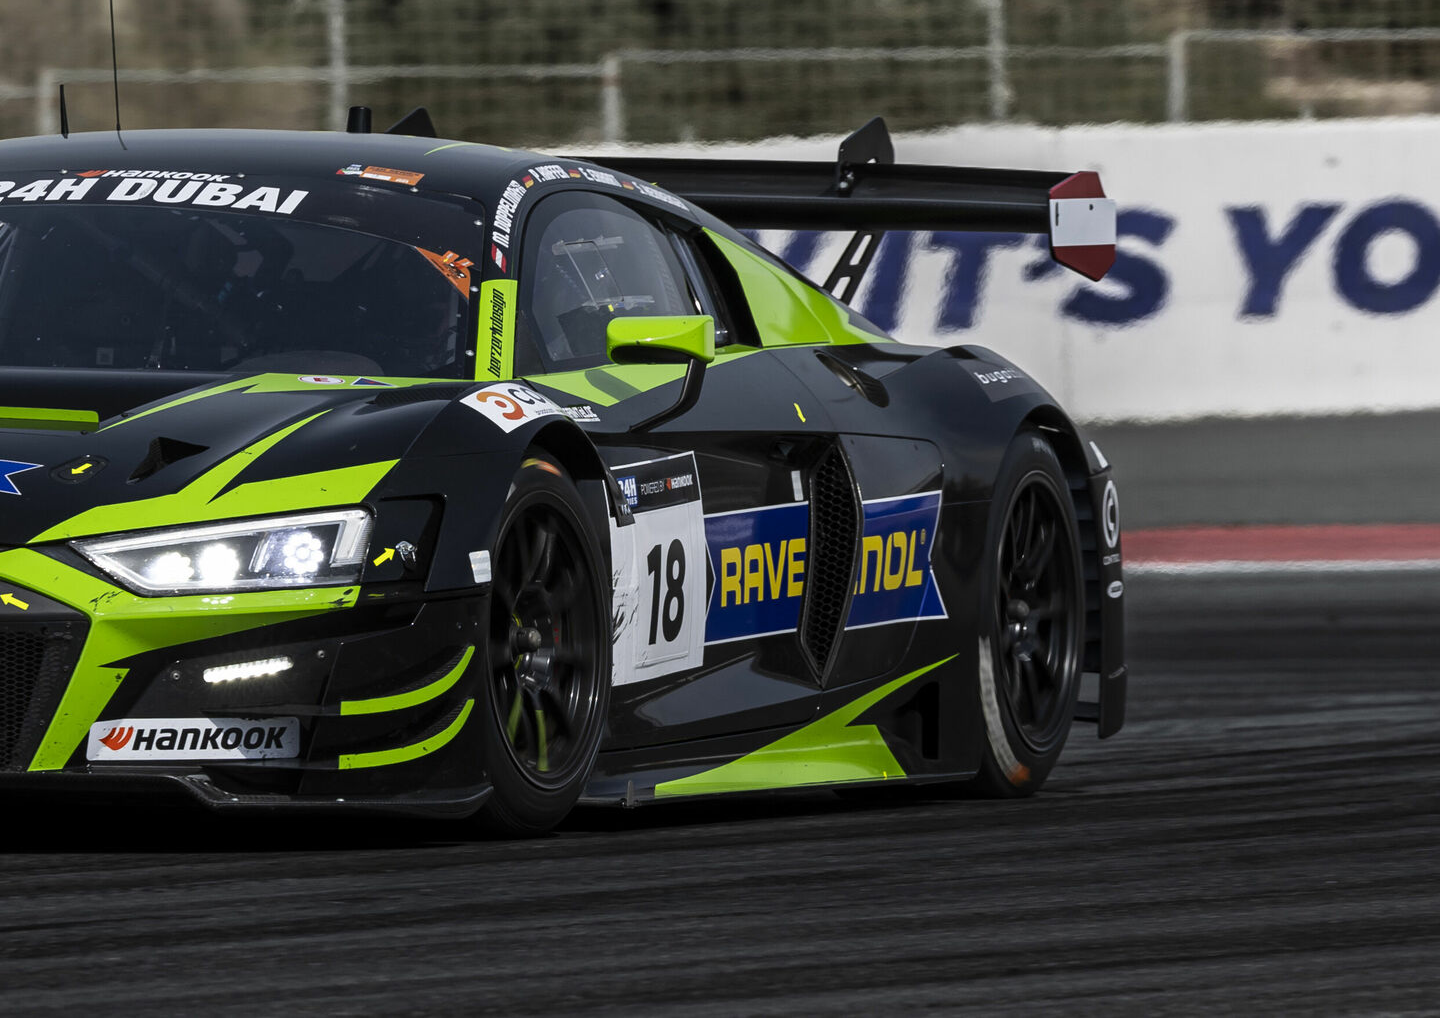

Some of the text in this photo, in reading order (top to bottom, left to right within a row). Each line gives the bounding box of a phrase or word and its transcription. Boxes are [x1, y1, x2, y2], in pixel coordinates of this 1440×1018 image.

[106, 177, 310, 215] DUBAI
[1223, 196, 1440, 322] YO
[647, 538, 686, 646] 18
